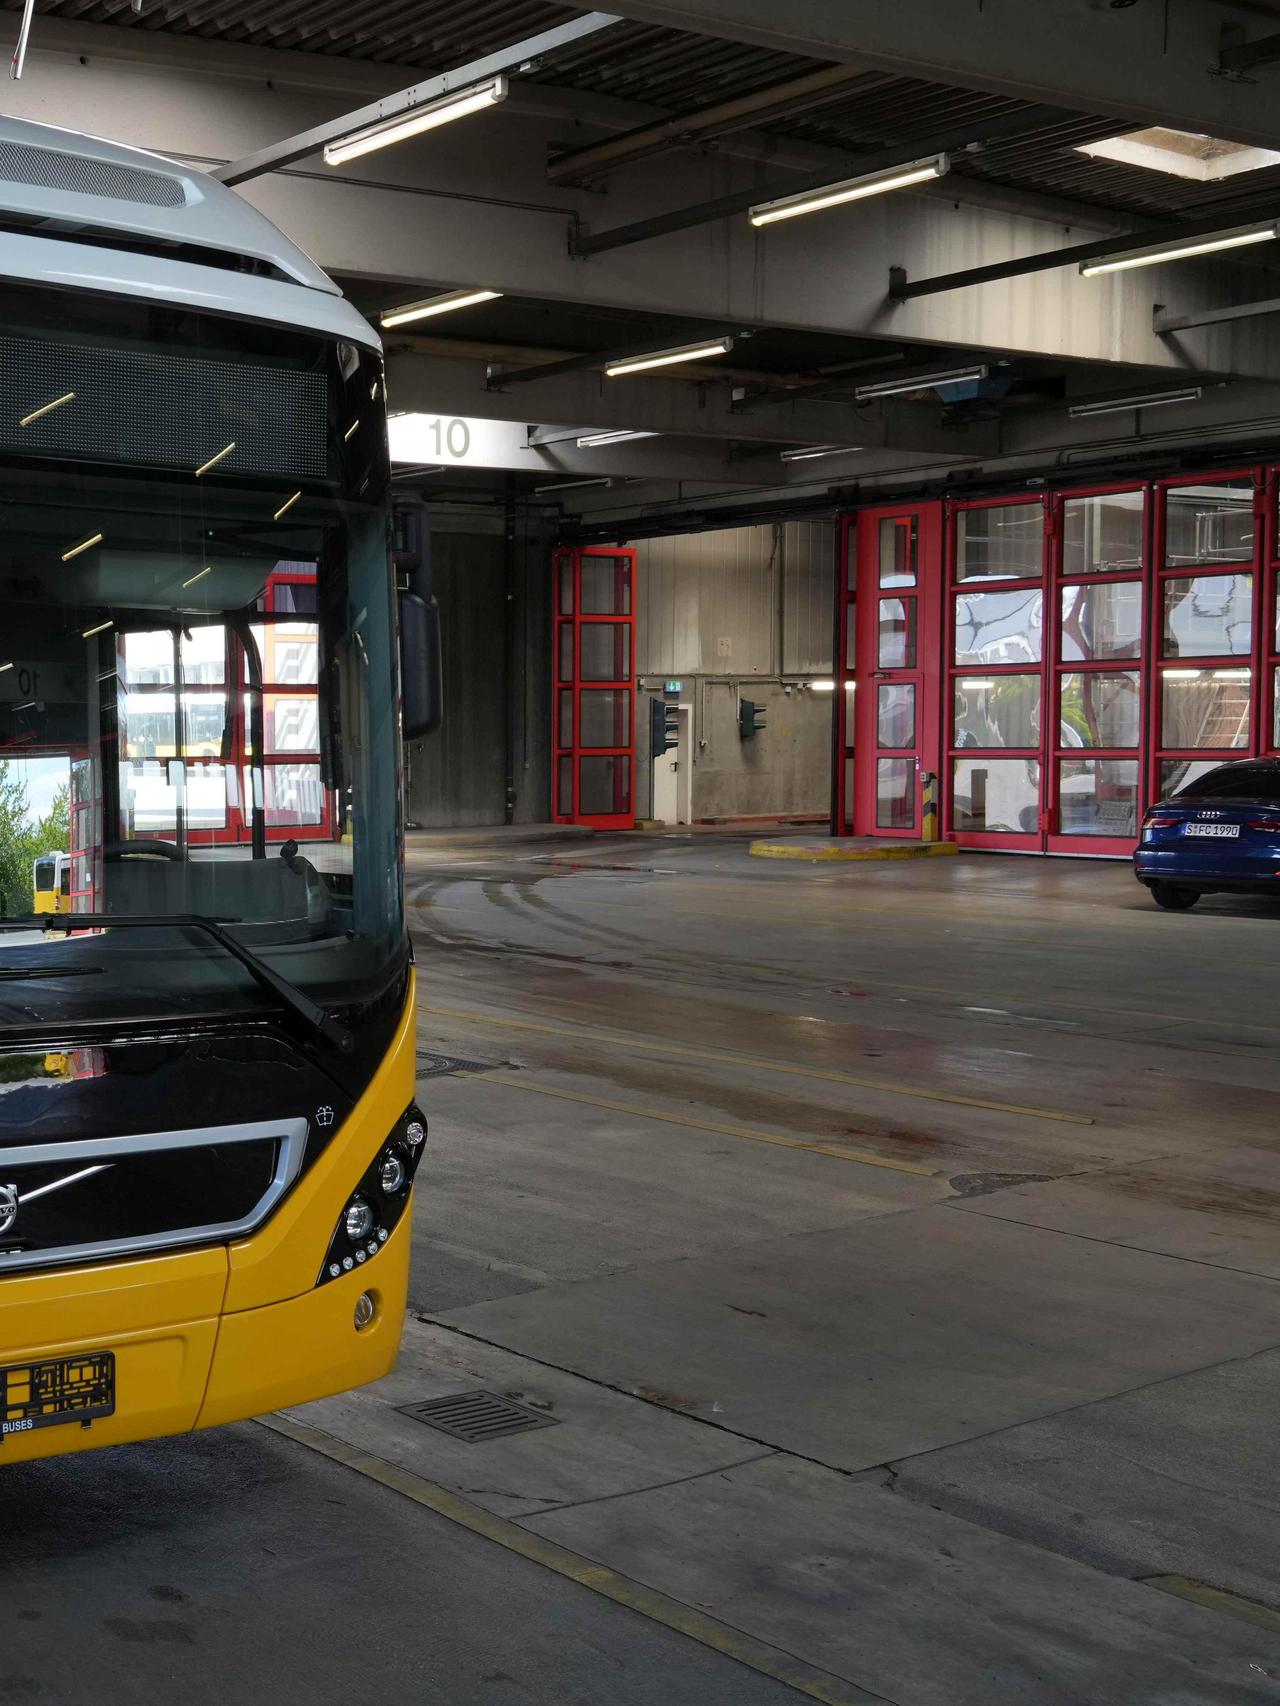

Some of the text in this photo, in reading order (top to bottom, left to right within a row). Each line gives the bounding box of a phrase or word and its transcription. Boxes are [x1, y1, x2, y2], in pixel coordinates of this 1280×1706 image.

[429, 418, 471, 458] 10
[1187, 825, 1238, 836] S FC 1990
[2, 1419, 33, 1433] BUSES
